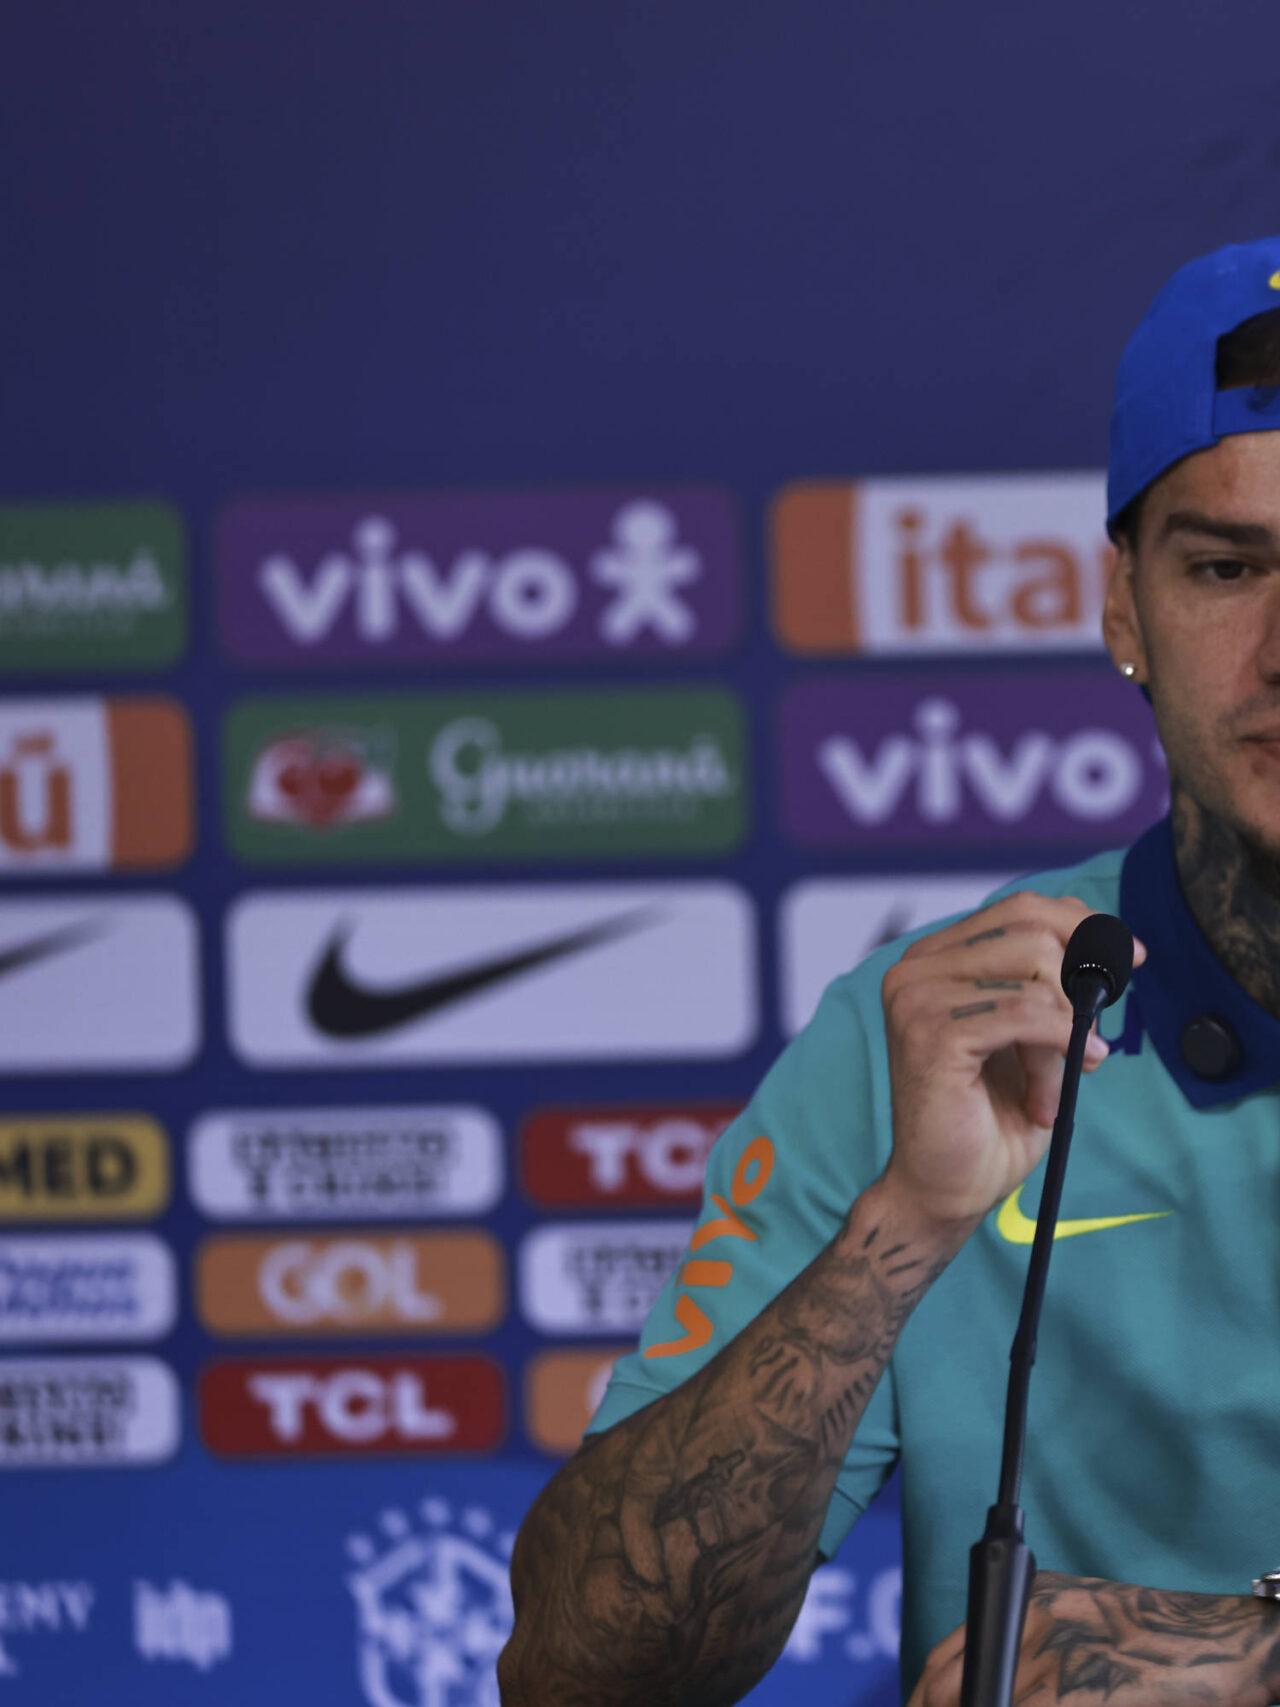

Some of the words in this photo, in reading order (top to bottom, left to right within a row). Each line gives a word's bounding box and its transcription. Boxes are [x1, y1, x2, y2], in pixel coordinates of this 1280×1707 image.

[258, 515, 578, 643] vivo
[893, 504, 1118, 636] ita
[819, 699, 1144, 825] vivo
[567, 1117, 740, 1194] TC
[245, 1367, 456, 1443] TCL
